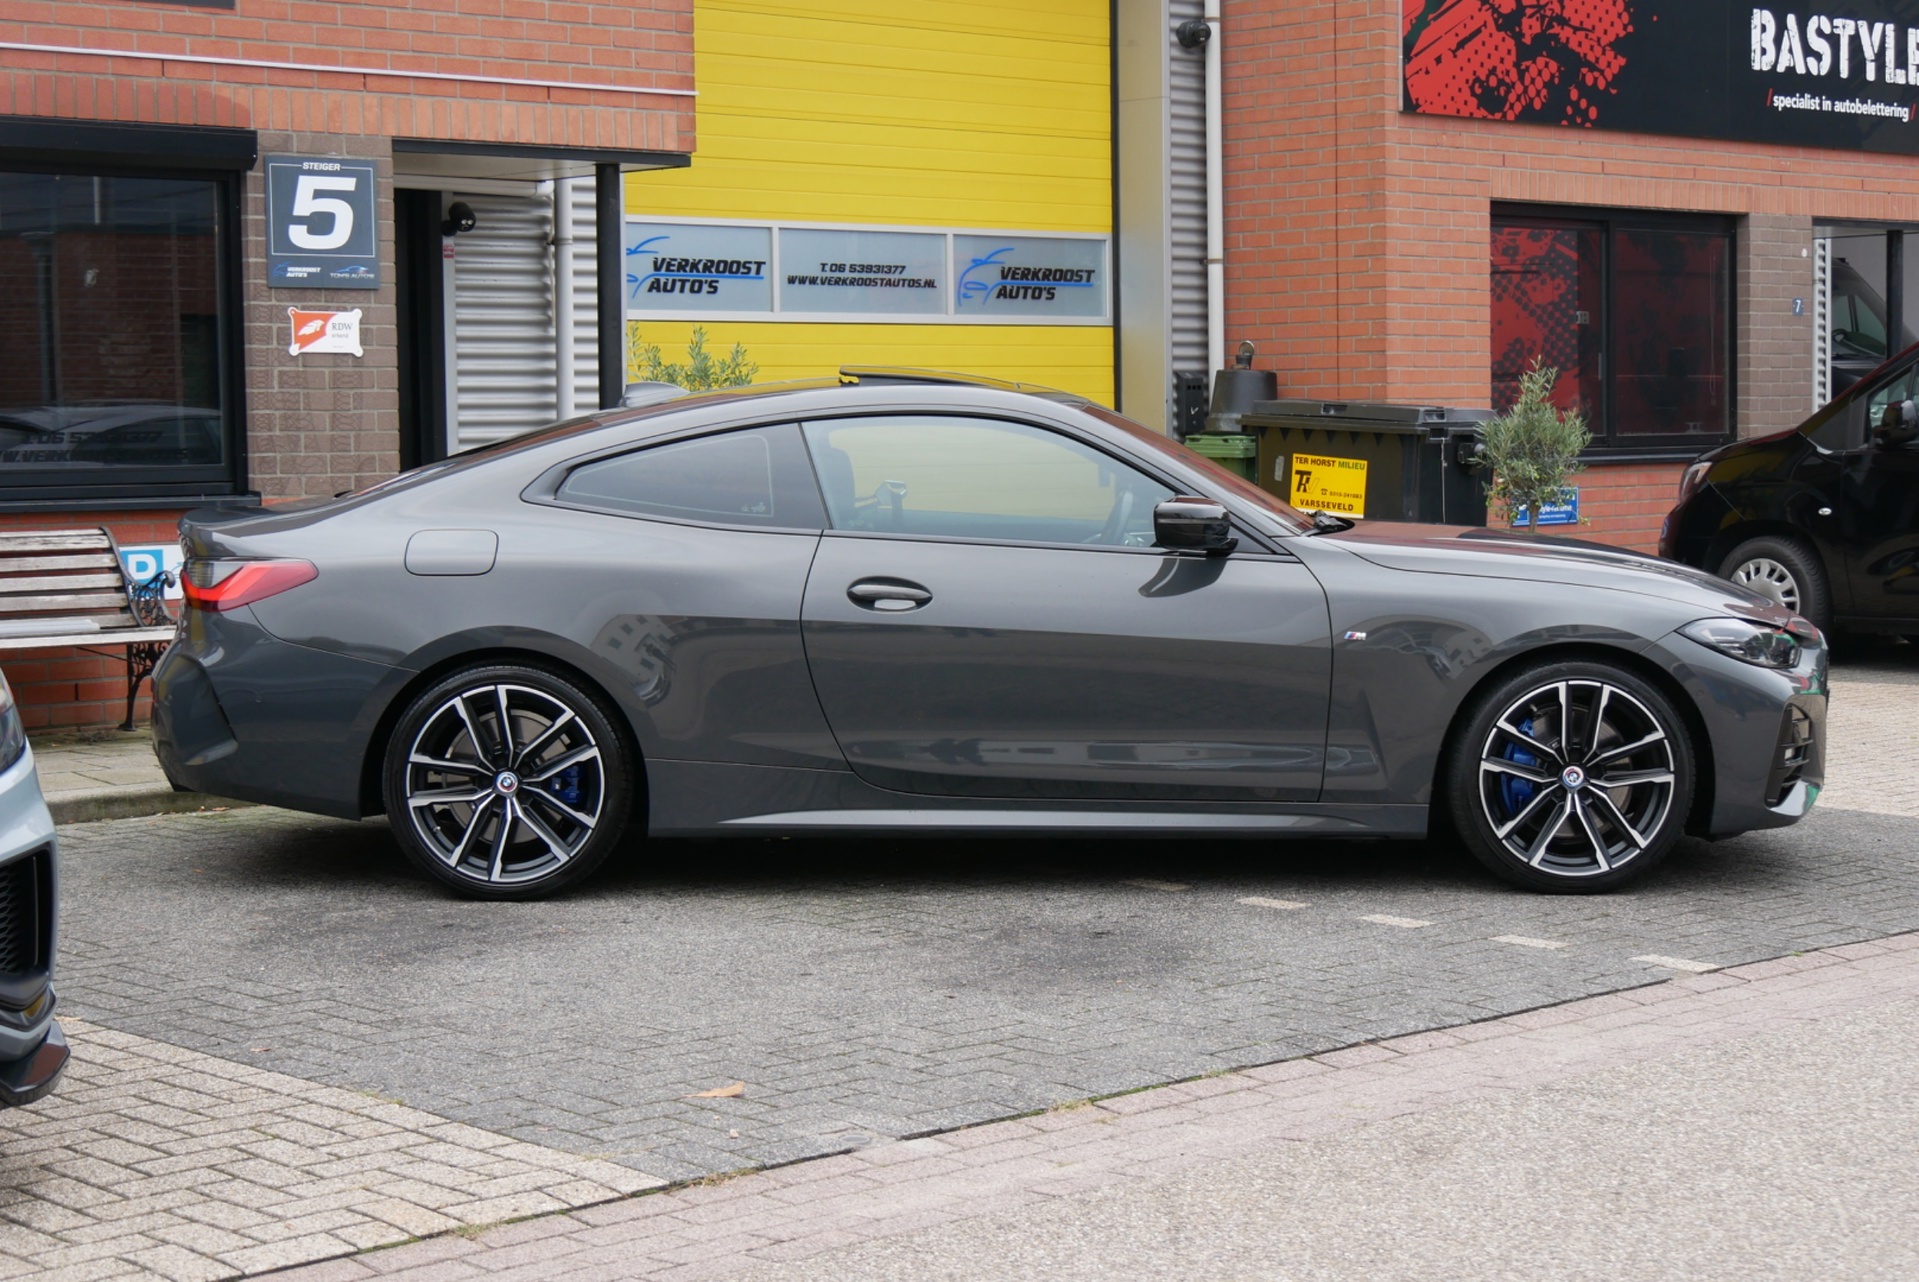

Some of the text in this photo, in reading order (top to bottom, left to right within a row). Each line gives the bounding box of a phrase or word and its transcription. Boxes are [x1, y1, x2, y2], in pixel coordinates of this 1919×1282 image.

[1822, 95, 1831, 111] in
[302, 161, 341, 172] STEIGER
[288, 175, 357, 250] 5
[652, 257, 766, 276] VERKROOST
[829, 263, 846, 273] 06
[848, 263, 906, 275] 53931377
[1000, 266, 1095, 283] VERKROOST
[647, 277, 719, 295] AUTO'S
[787, 275, 937, 289] WWW.VERKROOSTAUTOS.NL
[996, 285, 1056, 300] AUTO'S
[1796, 299, 1802, 313] 7
[331, 322, 353, 331] RDW
[1295, 456, 1365, 470] TER HORST MILIEU
[1300, 498, 1354, 511] VARSSEVELD
